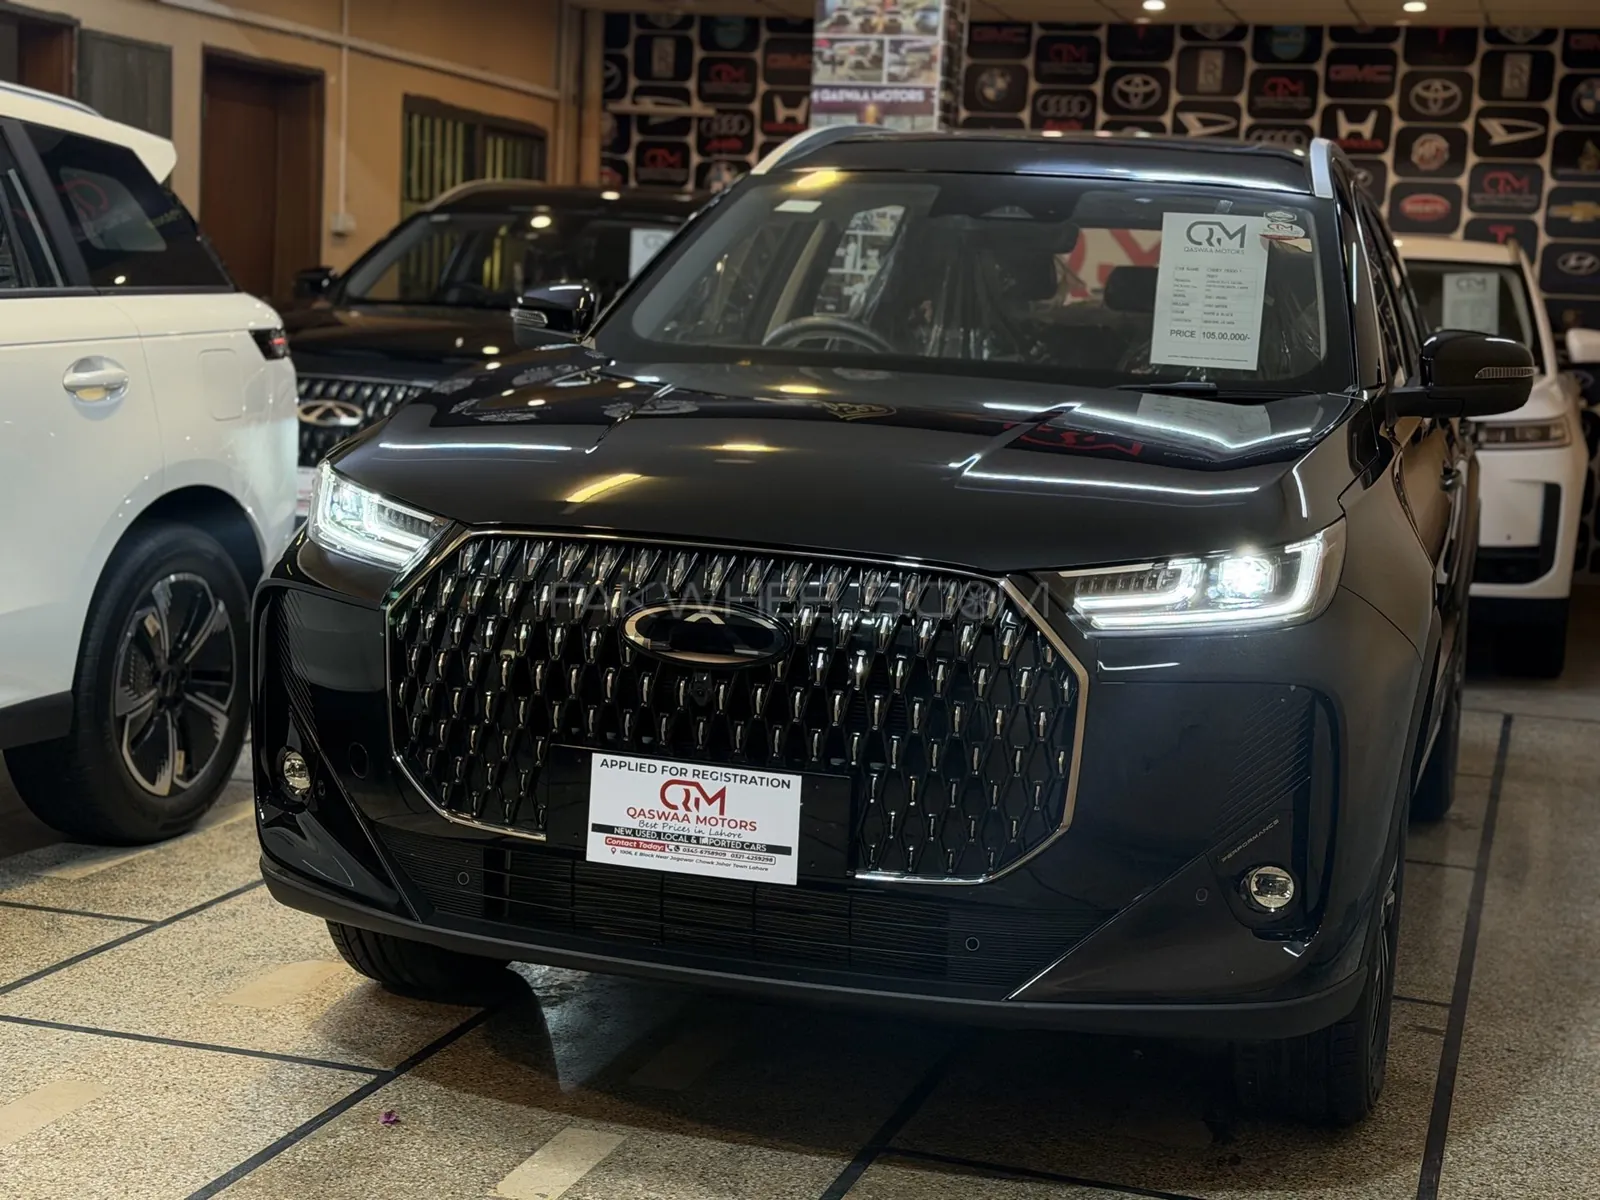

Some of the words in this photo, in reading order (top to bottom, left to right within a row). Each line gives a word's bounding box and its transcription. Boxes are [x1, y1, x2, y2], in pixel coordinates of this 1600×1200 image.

[1170, 330, 1196, 338] PRICE
[600, 758, 657, 774] APPLIED
[661, 765, 689, 777] FOR
[692, 769, 791, 790] REGISTRATION
[626, 806, 690, 824] QASWAA
[696, 814, 758, 832] MOTORS
[638, 819, 659, 830] Best
[662, 822, 690, 833] Prices
[694, 825, 705, 835] in
[708, 828, 743, 839] Lahore
[606, 837, 637, 848] Contact
[638, 841, 665, 852] Today:
[613, 826, 634, 837] NEW,
[635, 830, 659, 841] USED,
[660, 833, 689, 843] LOCAL
[690, 836, 697, 844] &
[699, 837, 742, 849] IMPORTED
[743, 842, 767, 852] CARS
